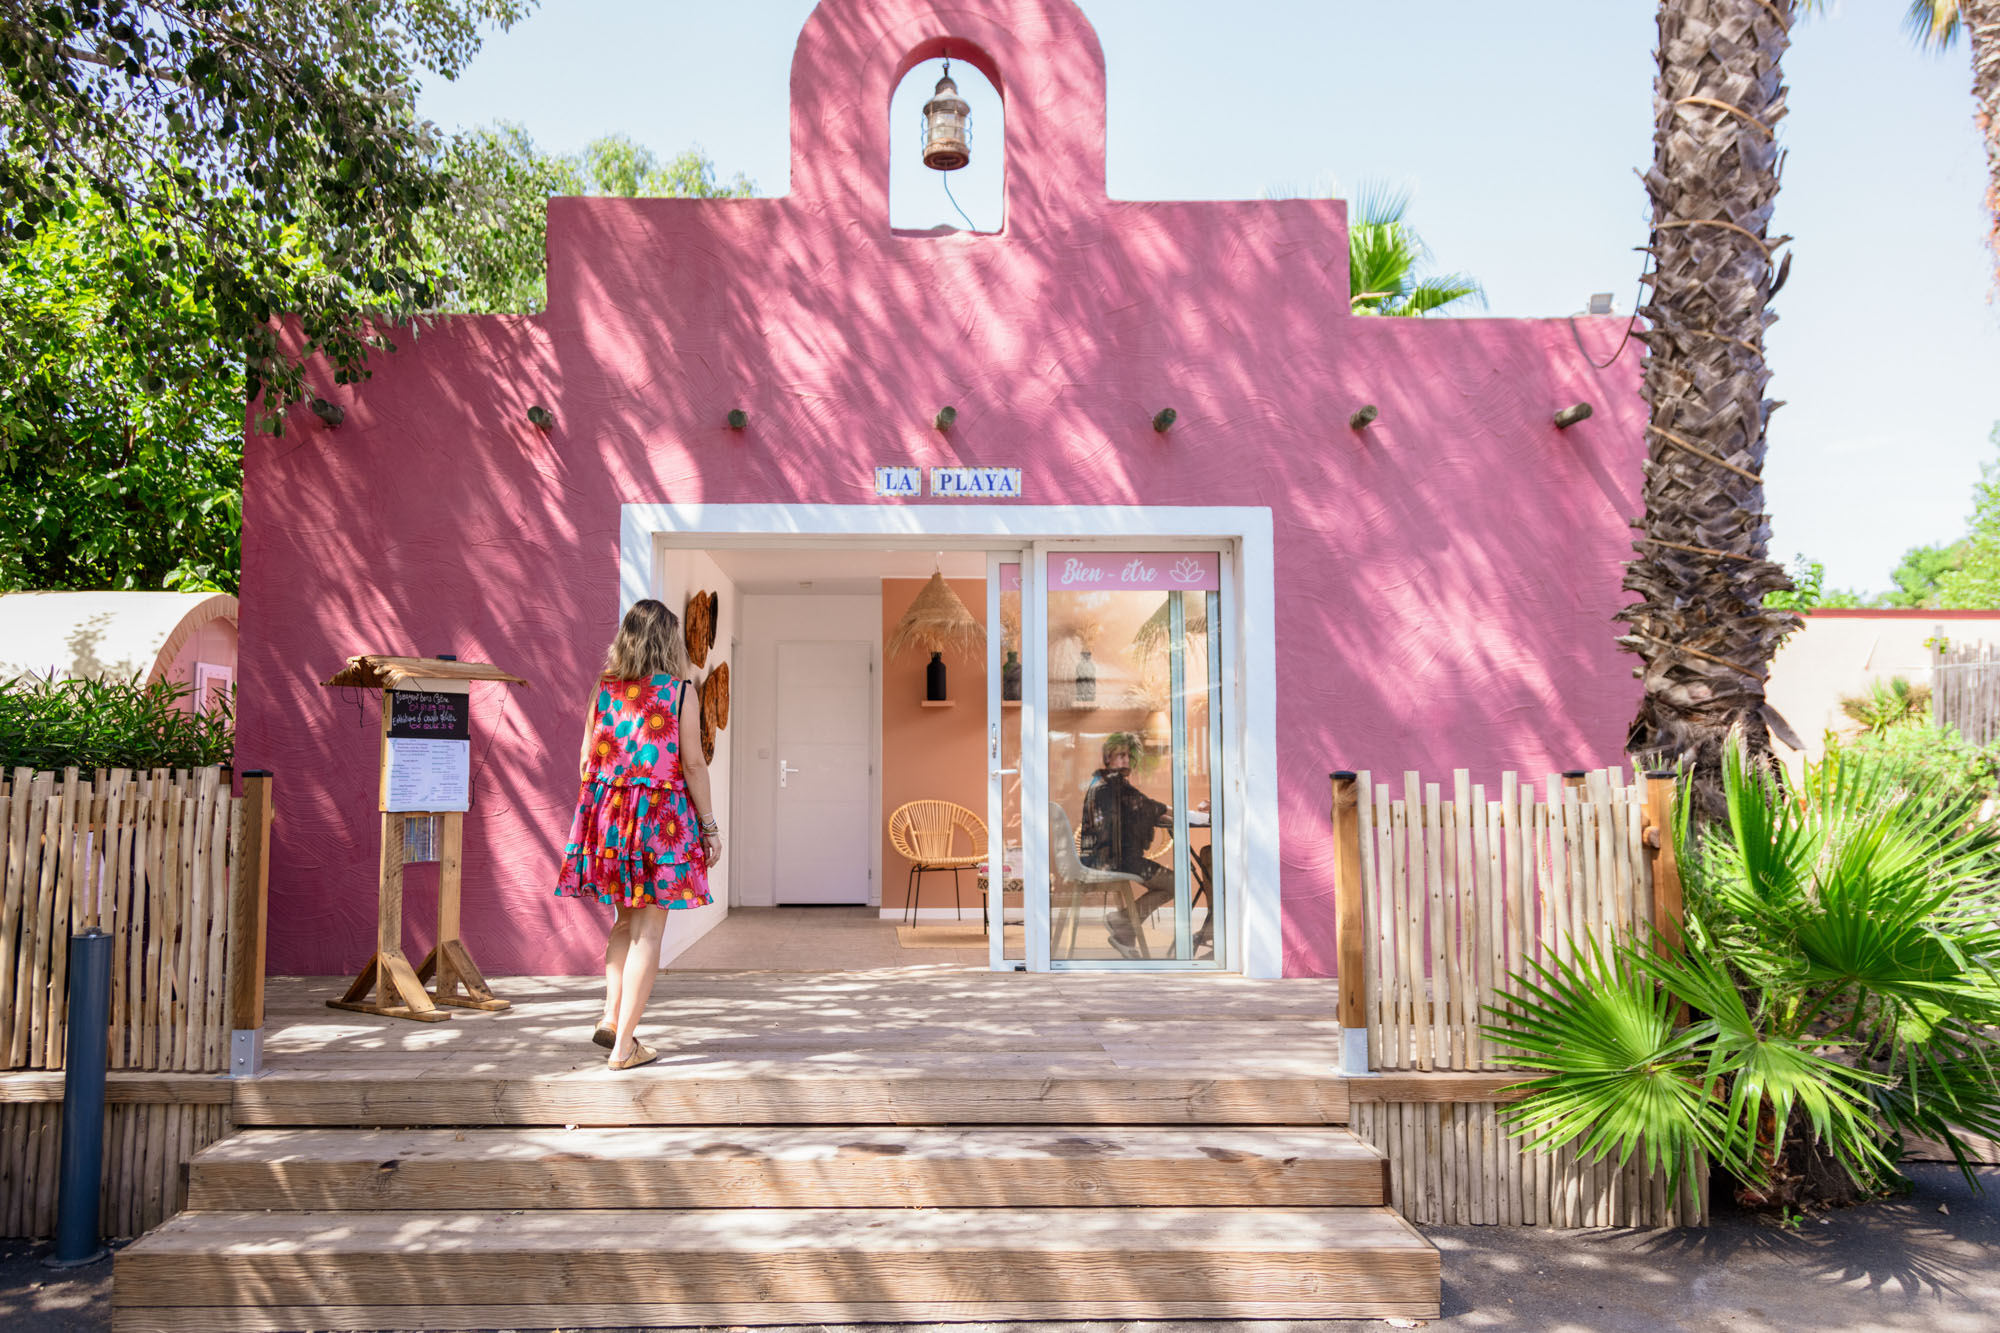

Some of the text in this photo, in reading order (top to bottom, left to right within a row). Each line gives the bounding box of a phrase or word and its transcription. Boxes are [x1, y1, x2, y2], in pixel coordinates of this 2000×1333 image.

[885, 473, 1013, 491] LA PLAYA
[1061, 558, 1104, 585] Bien
[1121, 558, 1159, 583] être
